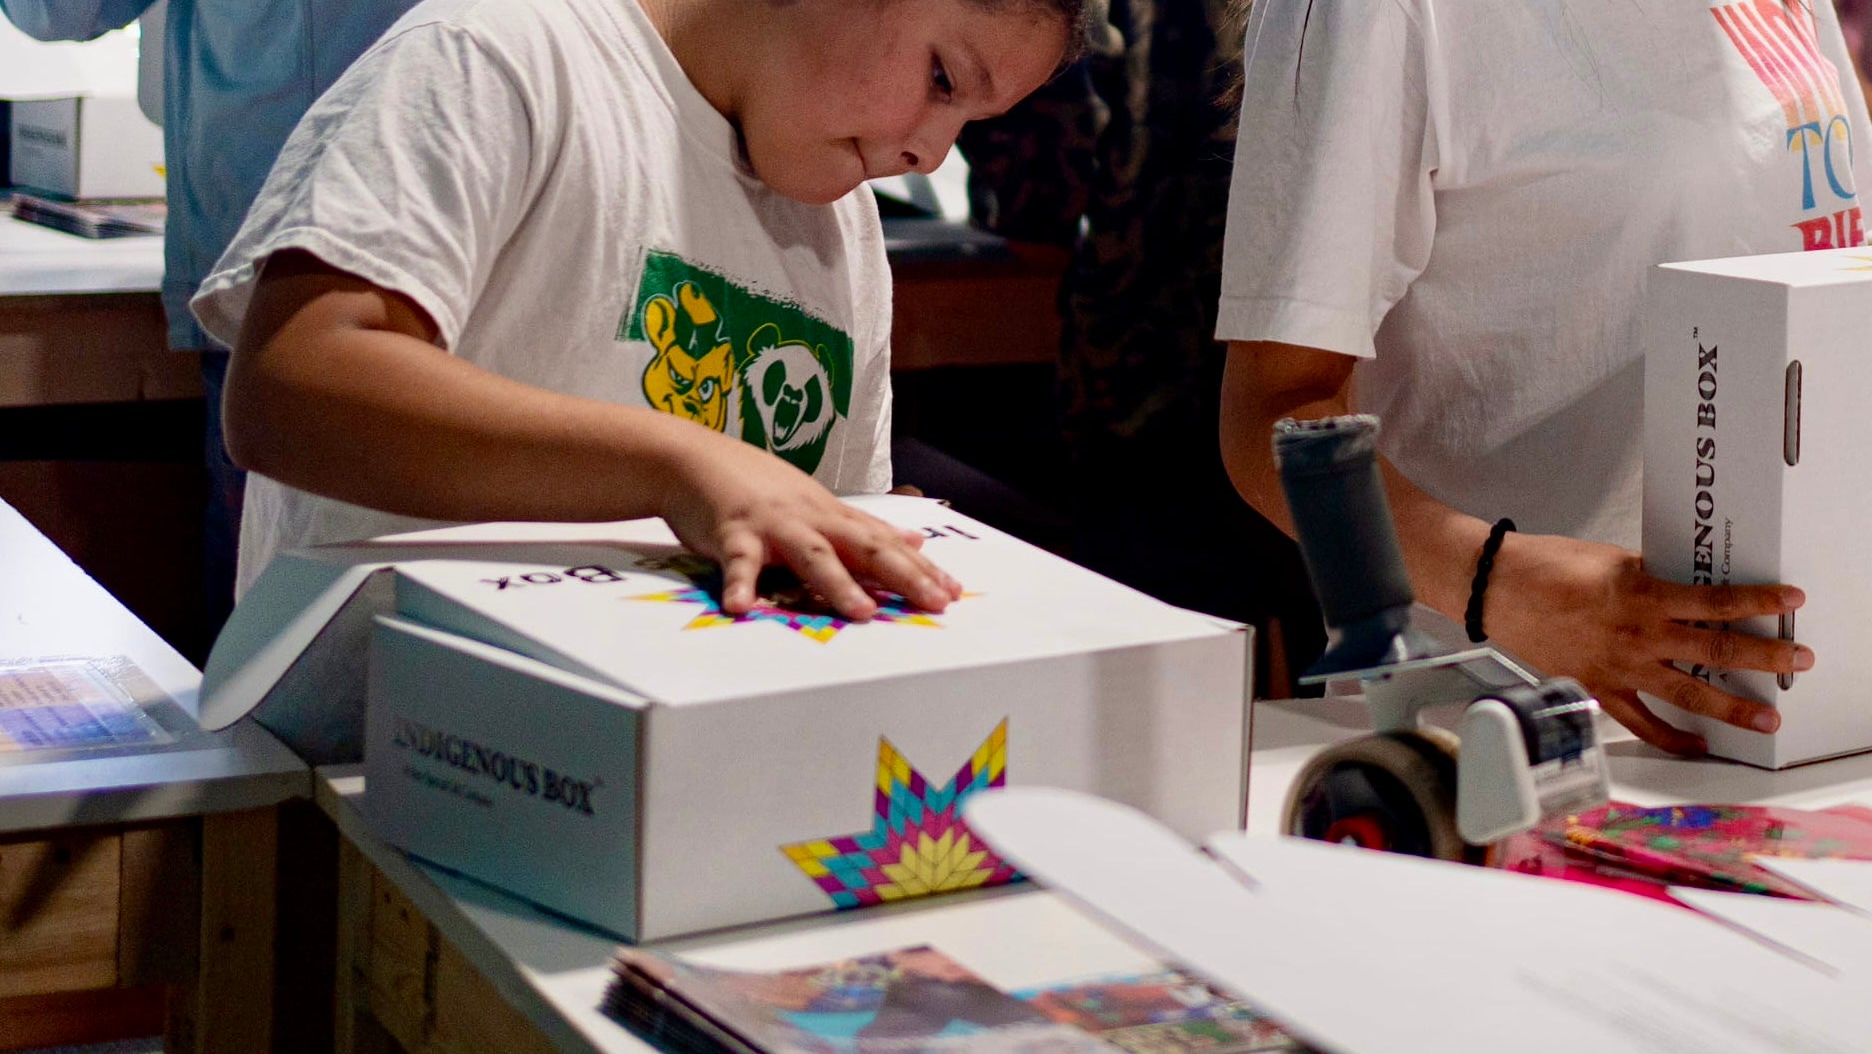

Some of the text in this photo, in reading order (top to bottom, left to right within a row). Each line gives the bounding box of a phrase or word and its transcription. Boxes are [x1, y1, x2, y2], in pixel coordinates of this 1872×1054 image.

[1721, 517, 1734, 577] Company
[479, 564, 630, 591] Box
[543, 766, 596, 817] BOX
